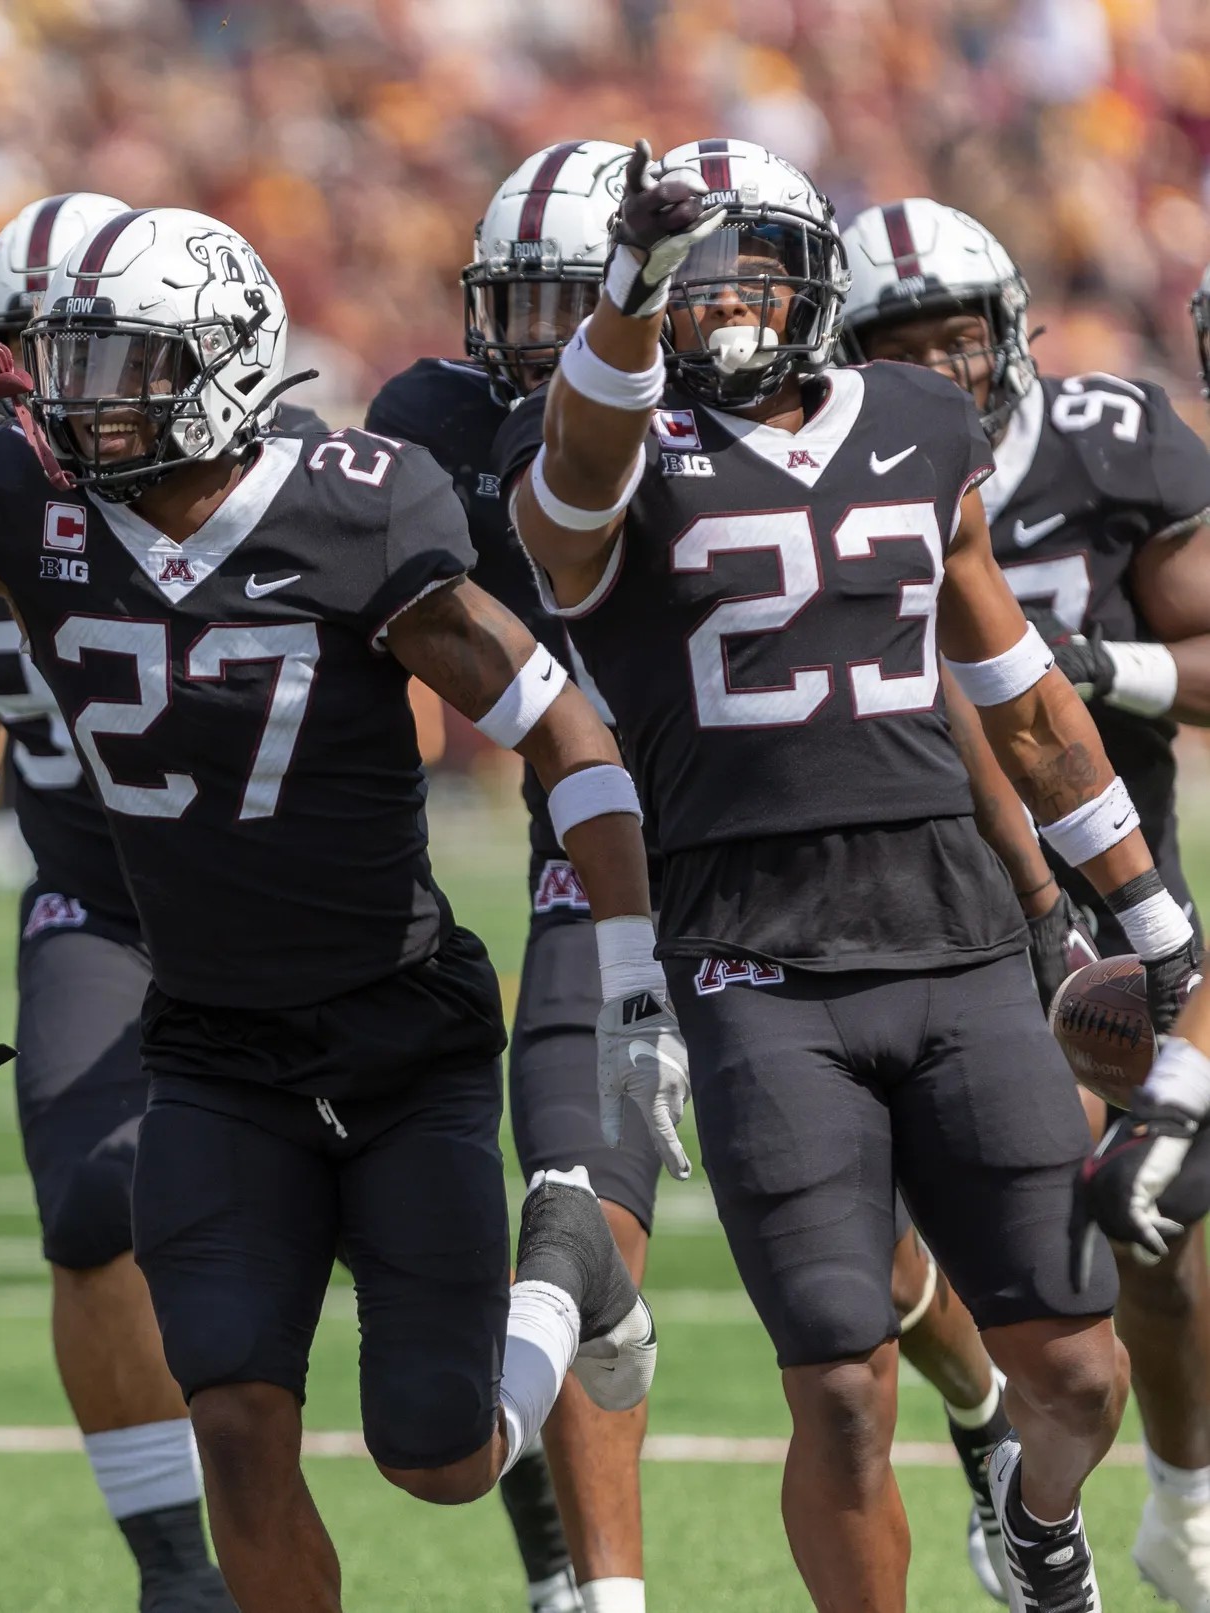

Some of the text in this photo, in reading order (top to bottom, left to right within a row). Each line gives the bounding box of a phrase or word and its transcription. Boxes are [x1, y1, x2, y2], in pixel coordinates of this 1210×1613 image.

[65, 297, 96, 313] ROW
[45, 502, 86, 551] C
[158, 555, 196, 583] M
[669, 498, 946, 730] 23
[50, 611, 321, 822] 27
